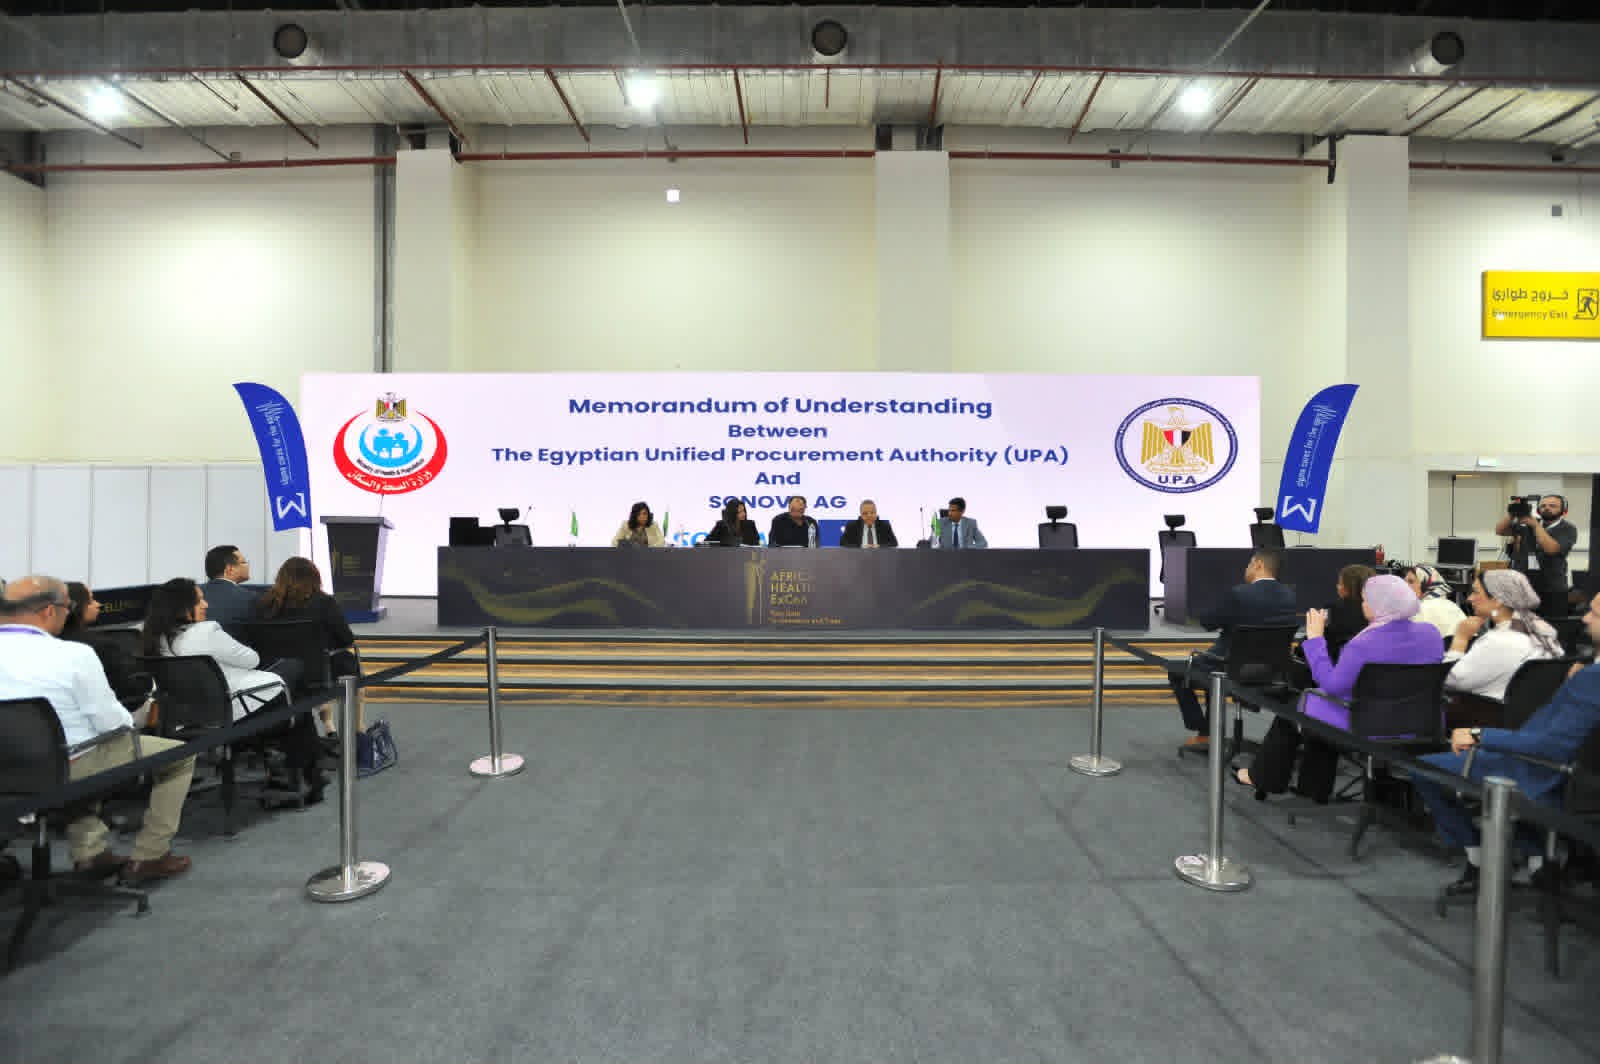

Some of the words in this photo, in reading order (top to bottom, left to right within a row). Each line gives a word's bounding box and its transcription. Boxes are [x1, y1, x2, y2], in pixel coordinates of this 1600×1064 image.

[568, 397, 758, 414] Memorandum
[763, 396, 790, 414] of
[795, 397, 993, 420] Understanding
[727, 424, 828, 439] Between
[491, 447, 533, 462] The
[537, 446, 640, 467] Egyptian
[645, 446, 726, 462] Unified
[731, 447, 884, 462] Procurement
[888, 447, 998, 467] Authority
[1003, 444, 1069, 466] (UPA)
[754, 471, 801, 486] And
[708, 495, 807, 509] SONOV
[813, 495, 848, 509] AG
